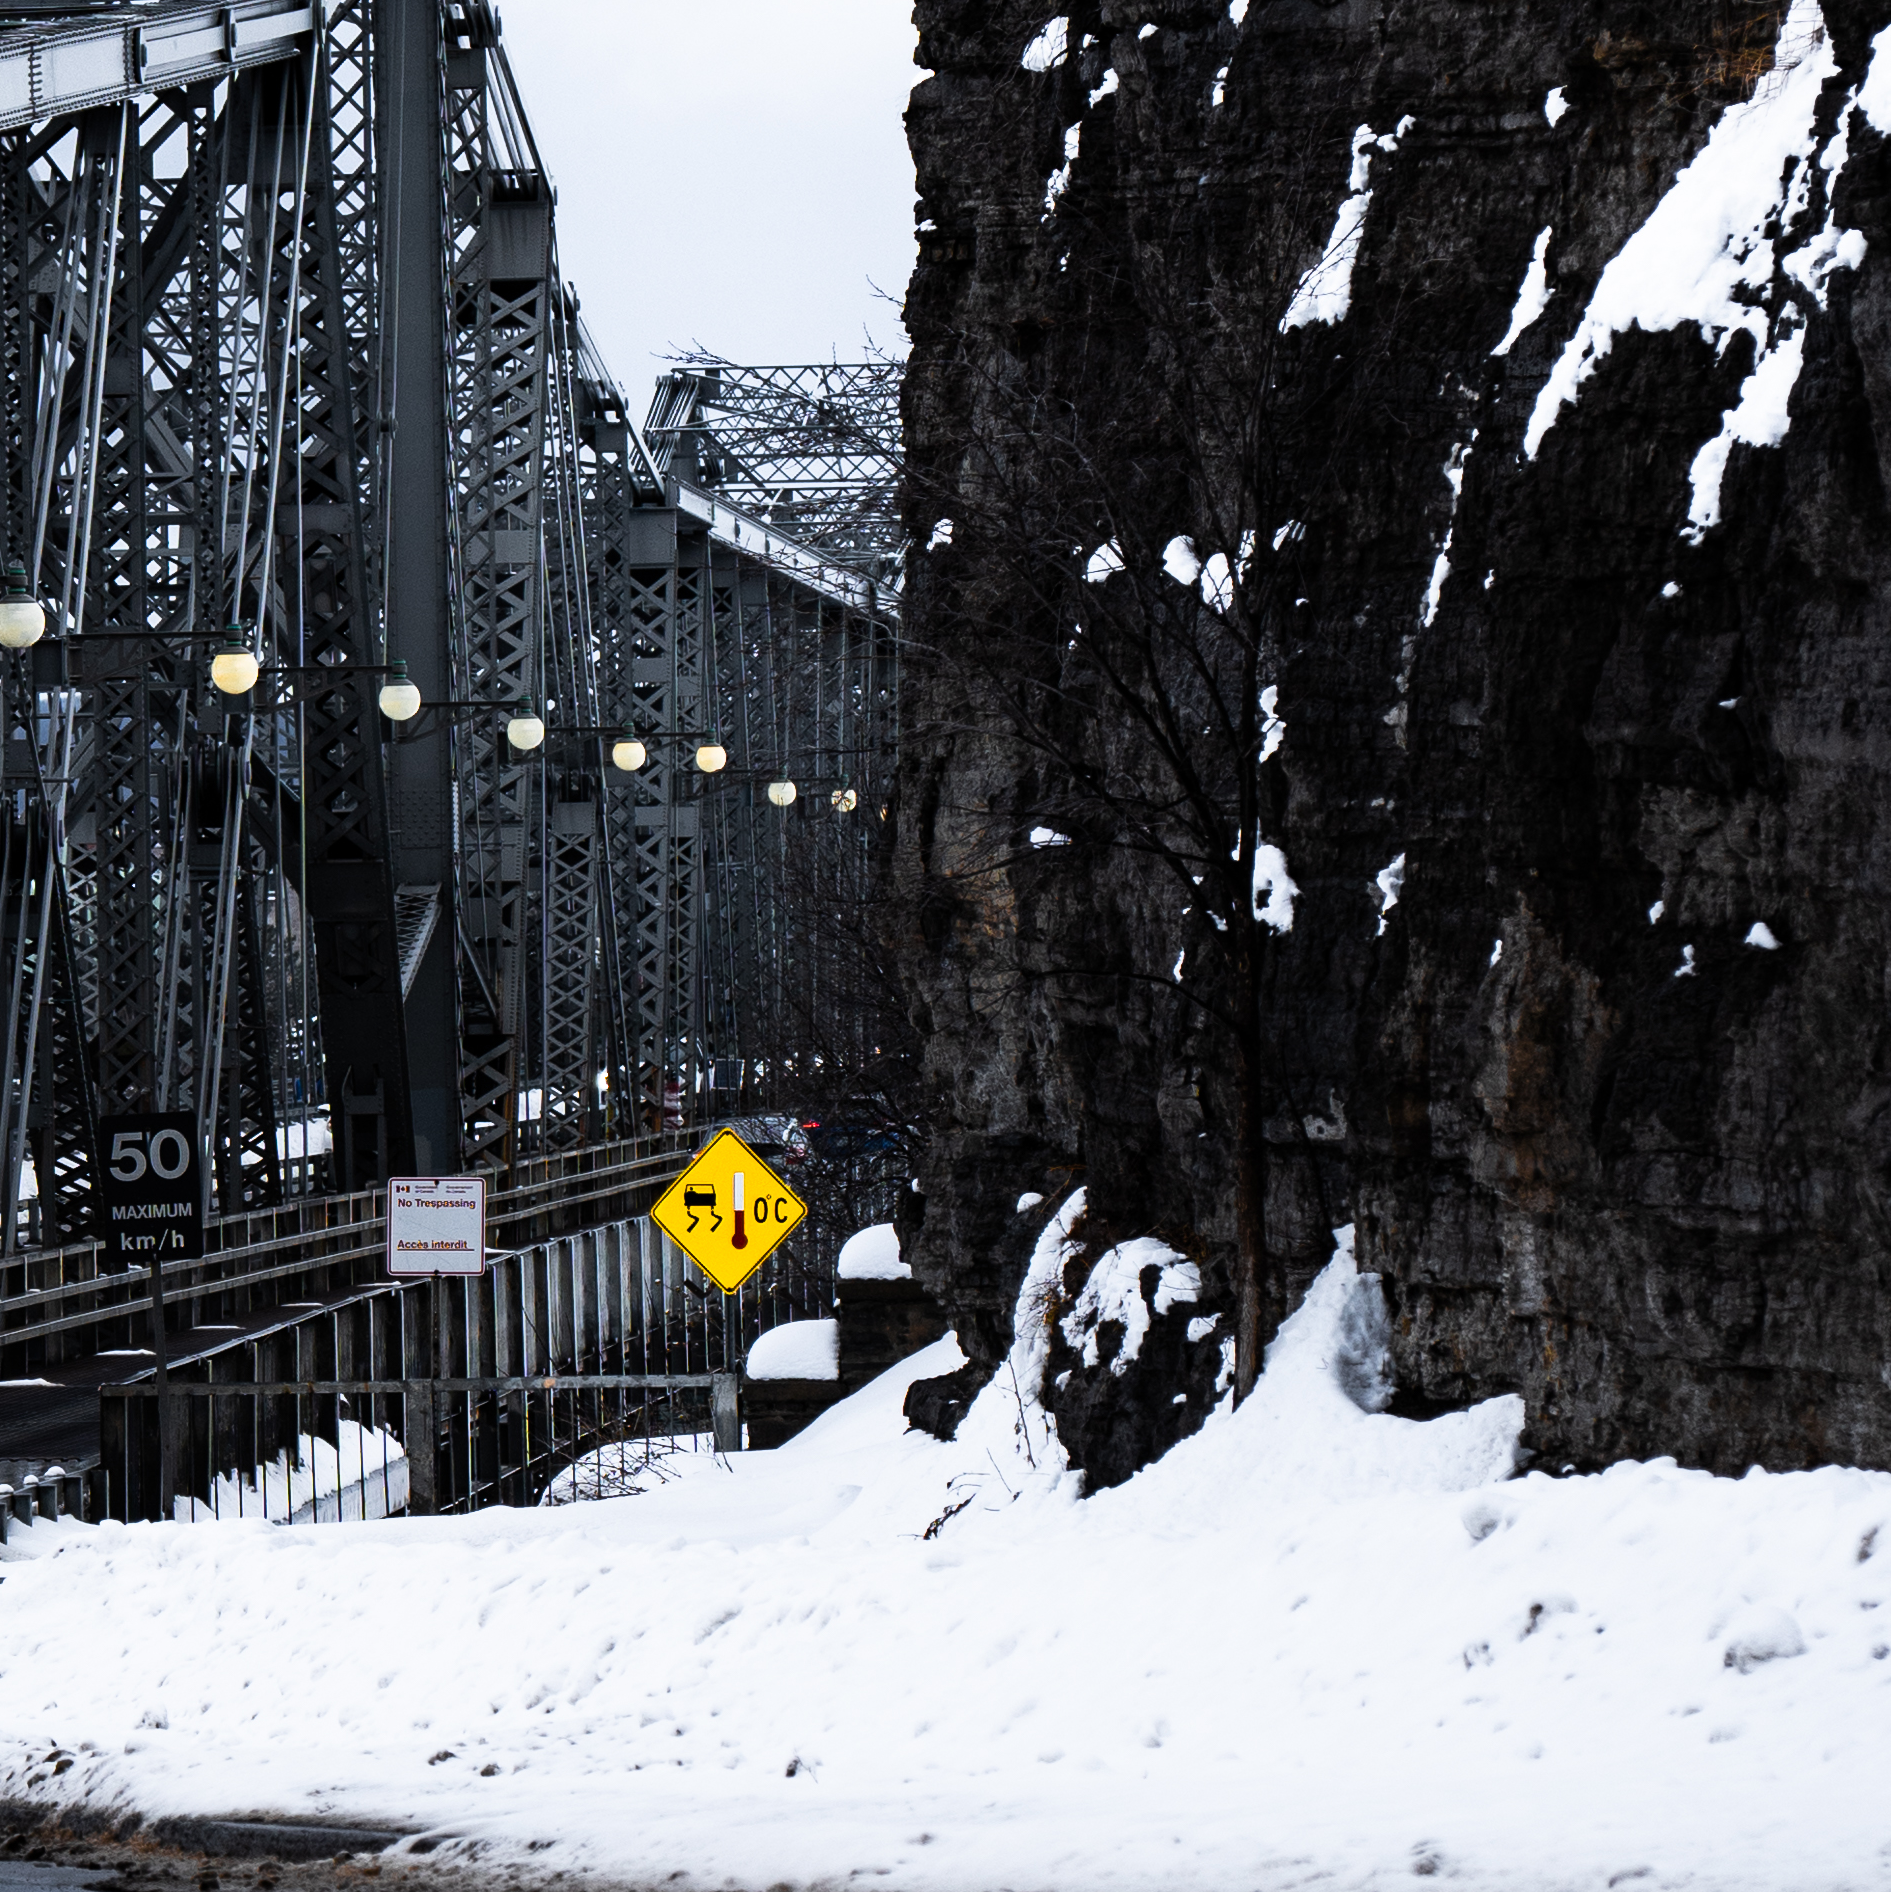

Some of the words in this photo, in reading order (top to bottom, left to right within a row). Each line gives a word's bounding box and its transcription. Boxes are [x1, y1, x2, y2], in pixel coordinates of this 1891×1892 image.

[109, 1128, 190, 1182] 50
[112, 1202, 192, 1220] MAXIMUM
[397, 1198, 412, 1208] No
[415, 1198, 476, 1209] Trespassing
[121, 1229, 185, 1250] km/h
[397, 1239, 428, 1249] Accès
